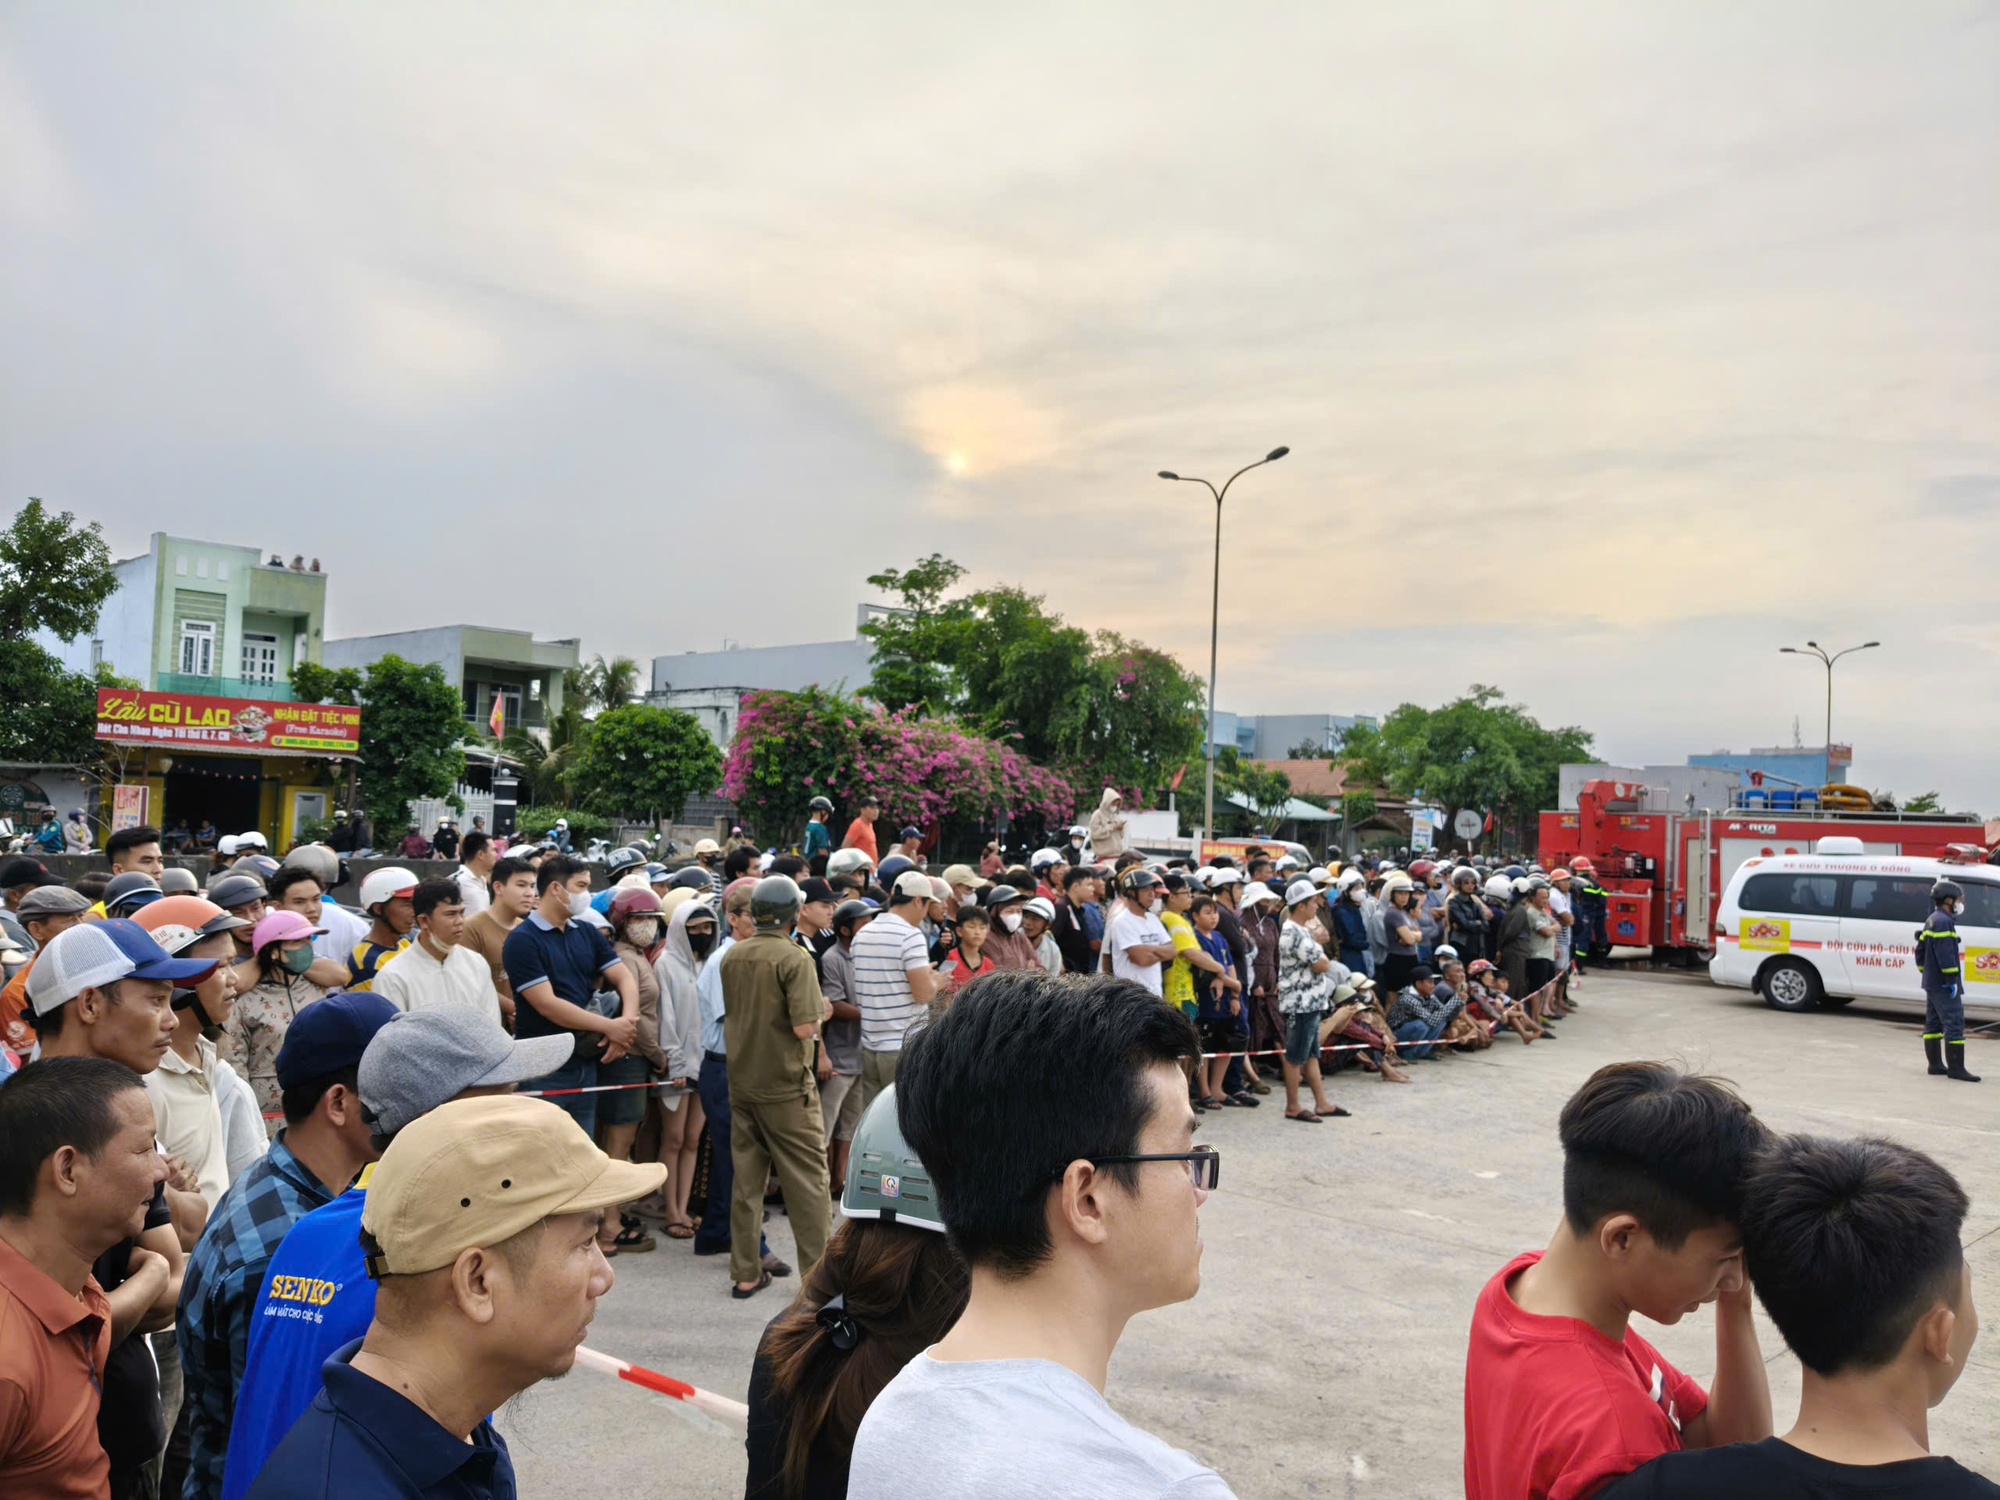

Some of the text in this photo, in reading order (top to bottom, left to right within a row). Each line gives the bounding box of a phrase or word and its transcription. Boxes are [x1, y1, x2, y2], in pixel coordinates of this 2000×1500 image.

[149, 700, 180, 724] CÙ
[185, 706, 231, 727] LAO
[274, 707, 299, 722] NHẬN
[342, 713, 360, 725] MINI
